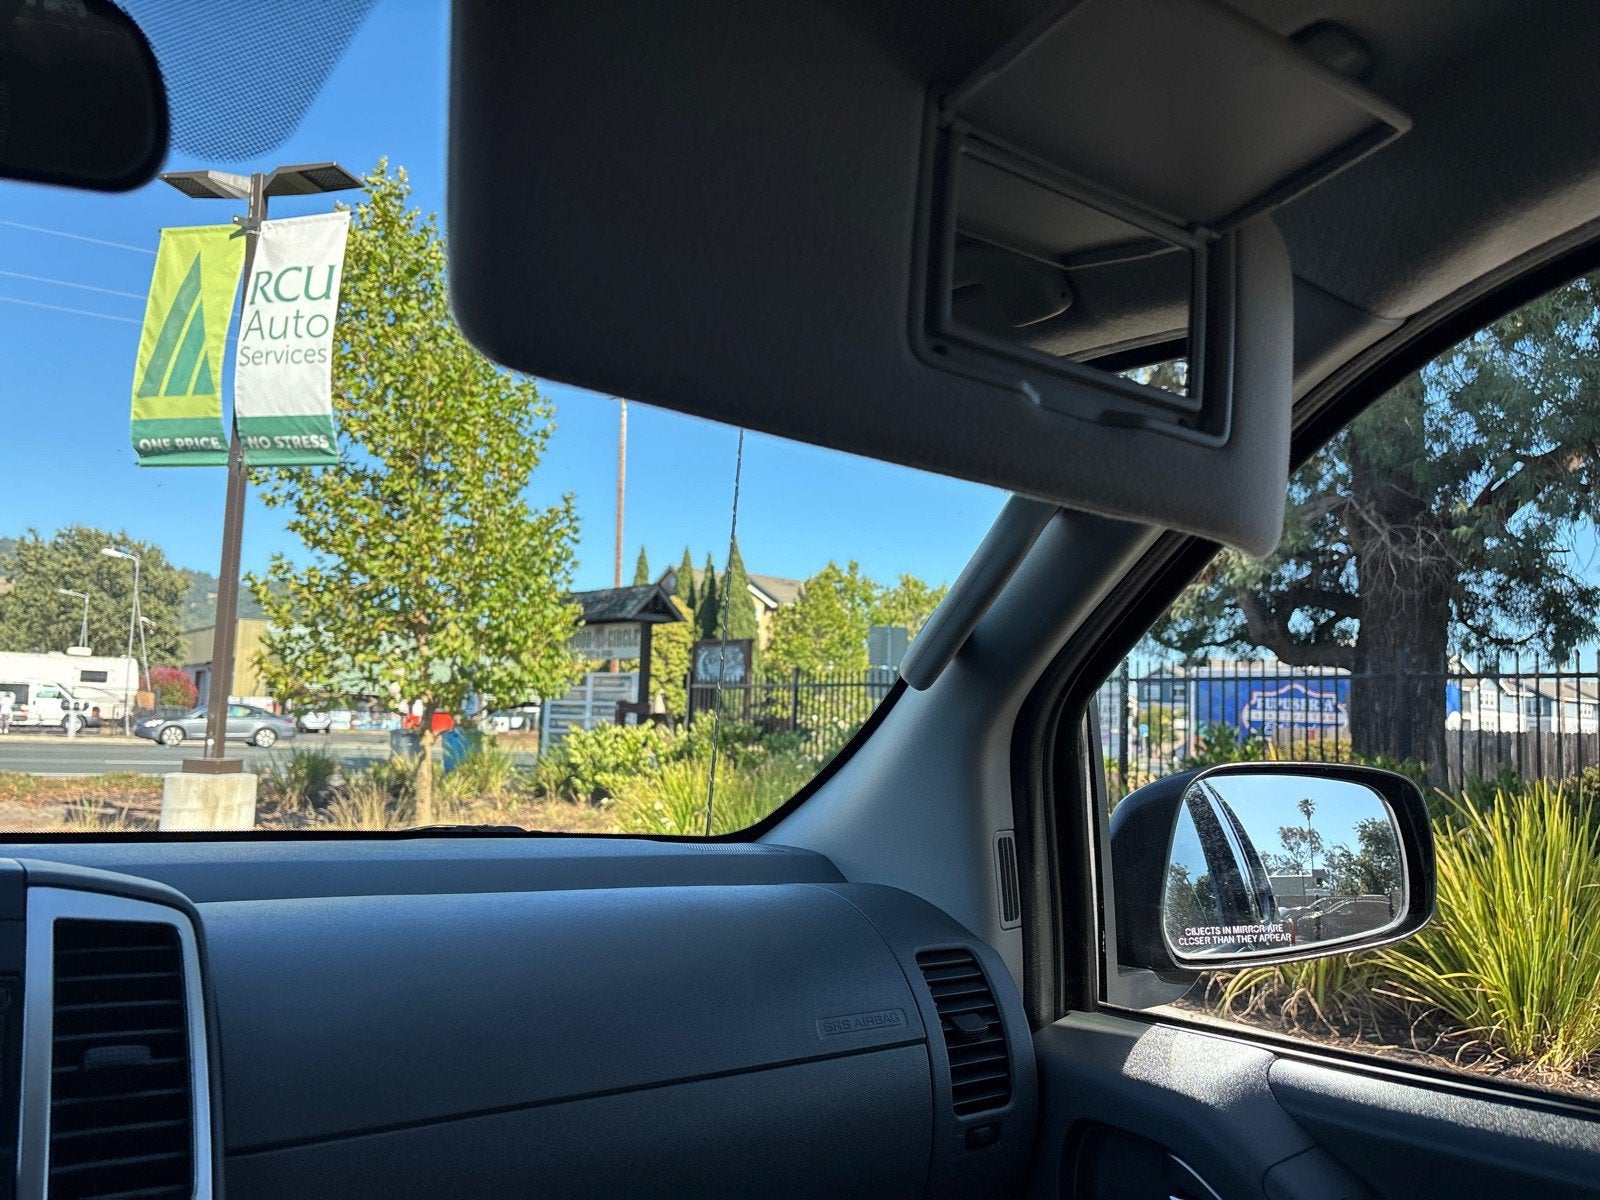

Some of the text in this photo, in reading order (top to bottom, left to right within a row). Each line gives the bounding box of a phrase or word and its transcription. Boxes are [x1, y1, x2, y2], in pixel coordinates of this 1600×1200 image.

[249, 264, 336, 306] RCU
[242, 309, 329, 342] Auto
[239, 344, 327, 367] Services
[139, 436, 221, 451] ONE PRICE
[247, 434, 329, 449] NO STRESS
[1185, 923, 1284, 936] OBJECTS IN MIRROR ARE
[1178, 932, 1292, 946] CLOSER THAN THEY APPEAR
[823, 1012, 900, 1033] SRS AIRBAG
